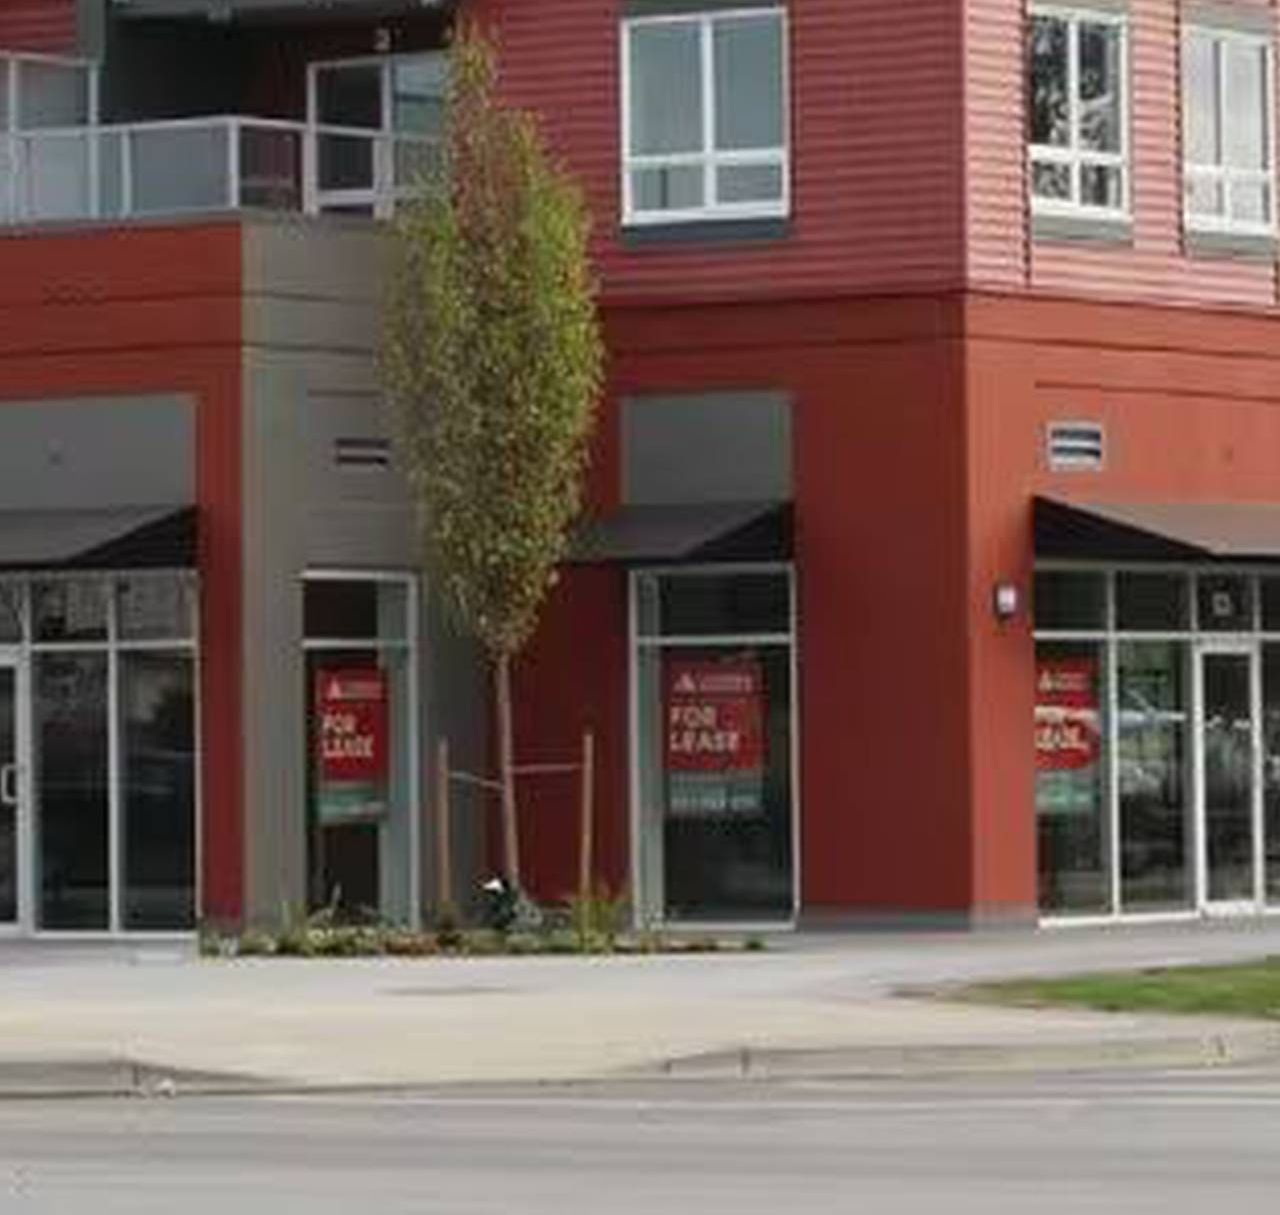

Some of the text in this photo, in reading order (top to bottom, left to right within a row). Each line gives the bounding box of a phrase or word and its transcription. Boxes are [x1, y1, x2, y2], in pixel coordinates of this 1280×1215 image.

[323, 713, 356, 734] FOR
[670, 705, 717, 728] FOR
[323, 736, 374, 758] LEASE
[670, 731, 739, 753] LEASE
